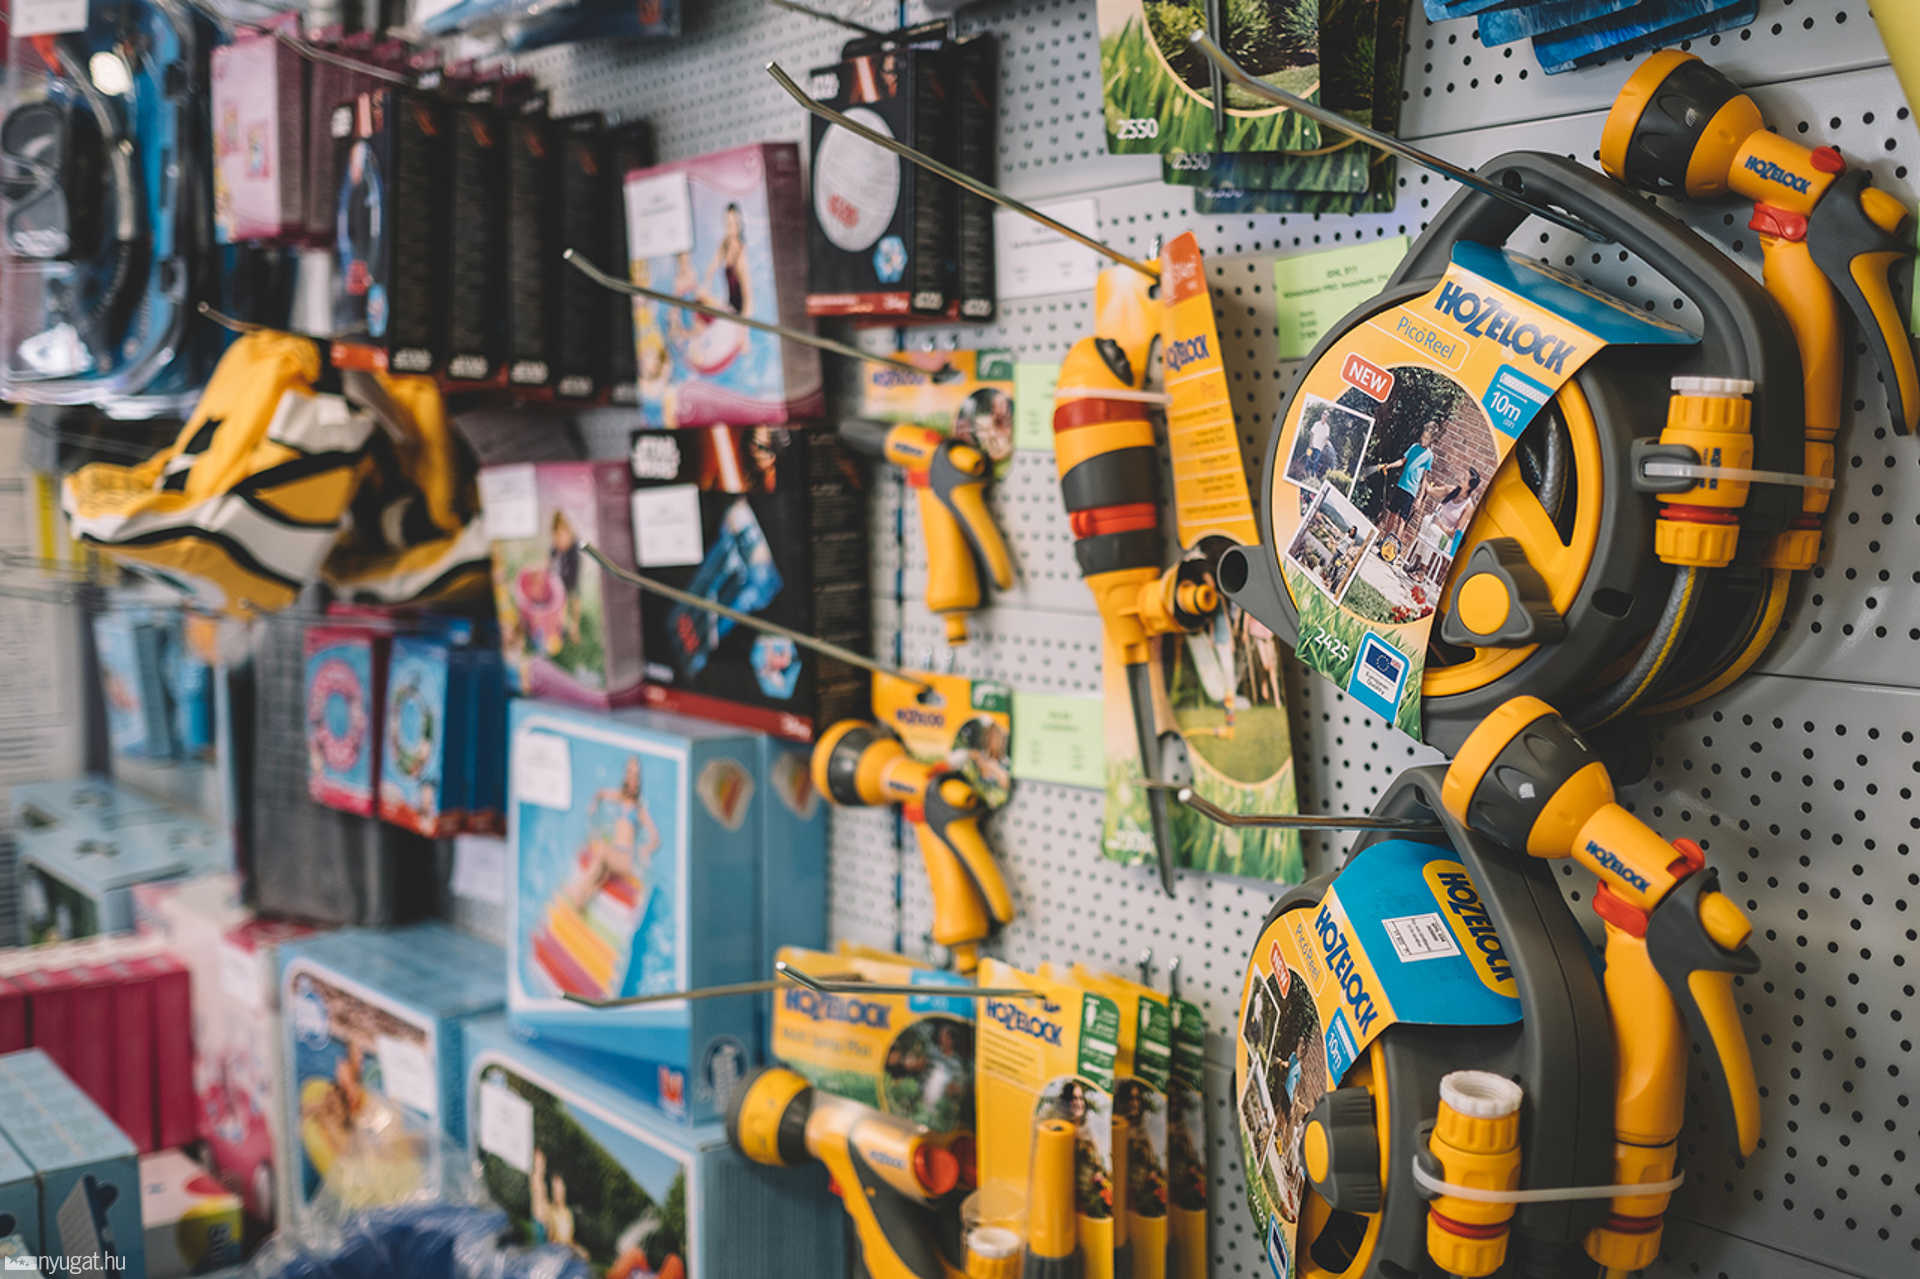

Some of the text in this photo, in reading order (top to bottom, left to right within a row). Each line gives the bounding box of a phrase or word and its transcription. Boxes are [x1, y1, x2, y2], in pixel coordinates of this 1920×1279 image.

[1116, 118, 1159, 139] 2550
[1744, 155, 1812, 194] HOZELOCK
[1434, 281, 1577, 375] HOZELOCK
[1349, 361, 1388, 393] NEW
[1490, 391, 1521, 422] 10m
[1313, 624, 1351, 661] 2425
[1585, 840, 1651, 895] HOZELOCK
[1315, 904, 1378, 1038] HOZELOCK
[785, 986, 892, 1030] HOZELOCK
[986, 998, 1064, 1048] HOZELOCK
